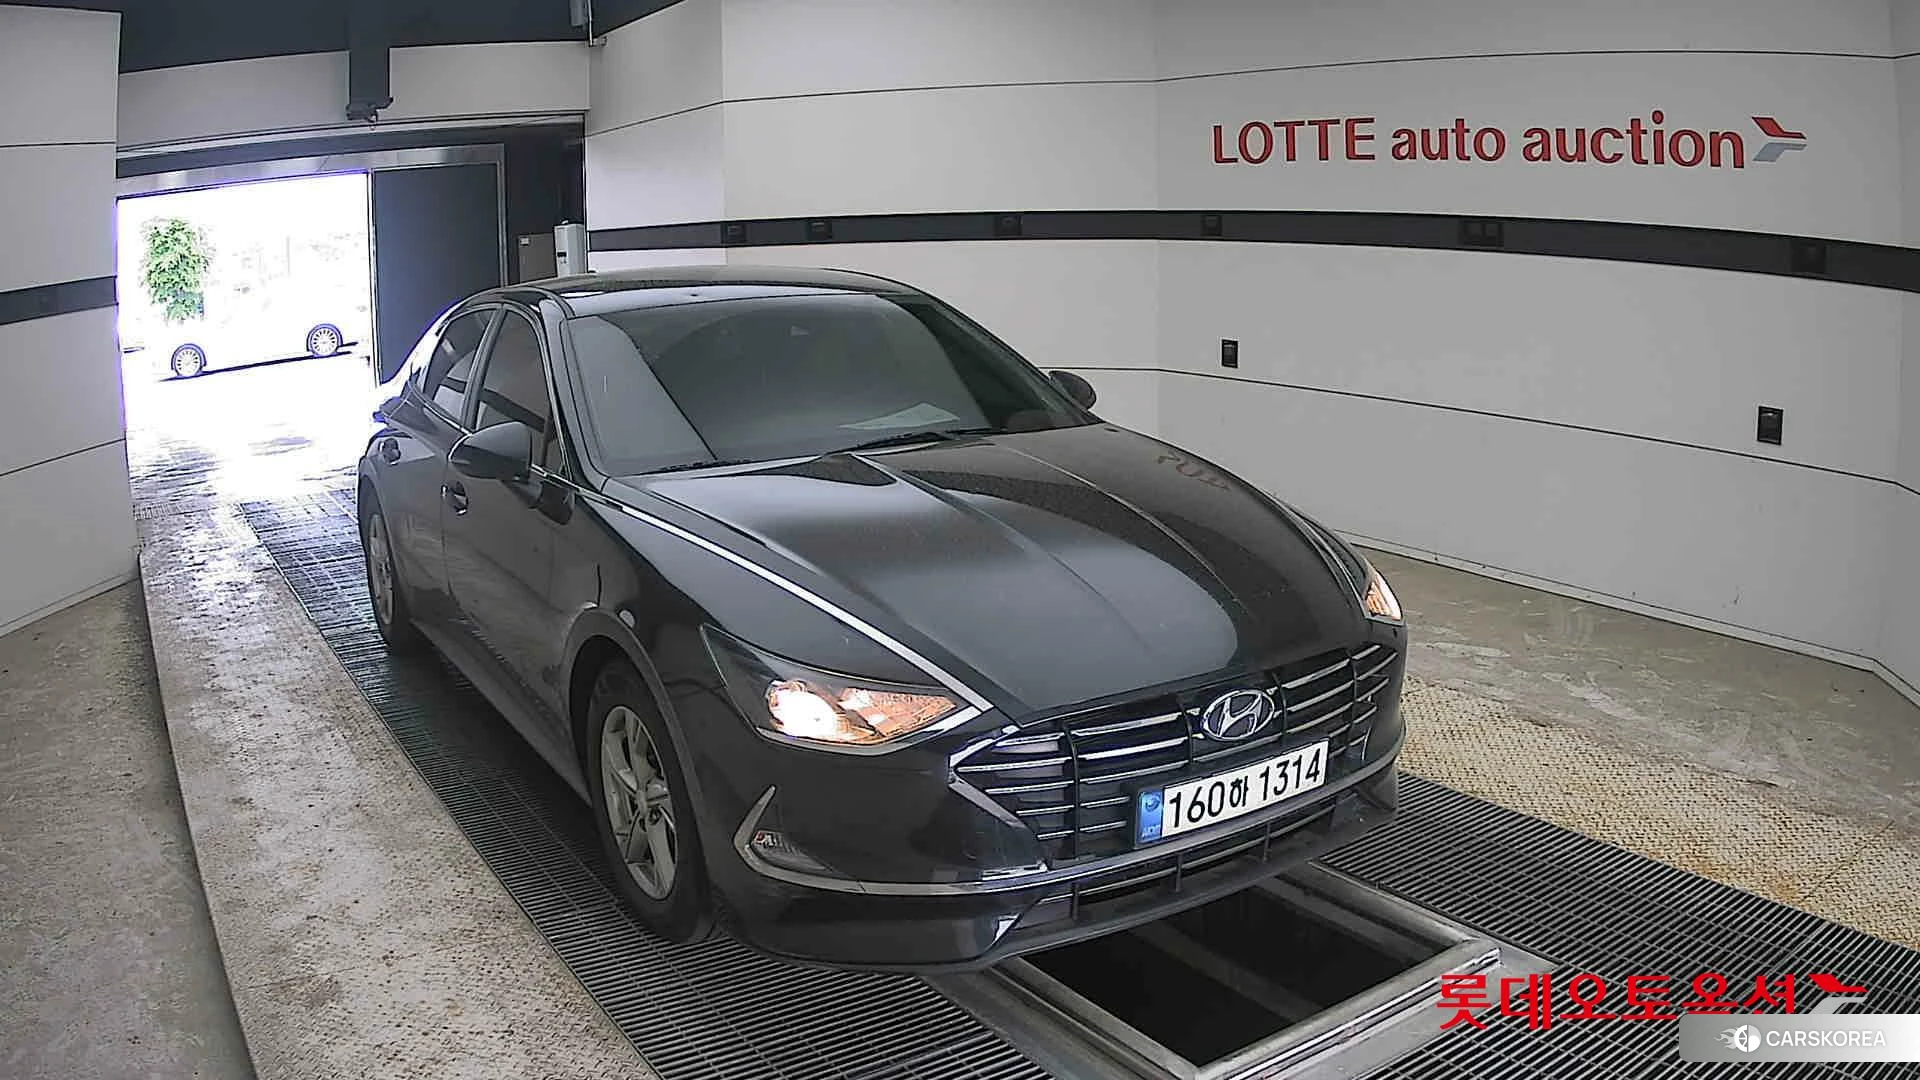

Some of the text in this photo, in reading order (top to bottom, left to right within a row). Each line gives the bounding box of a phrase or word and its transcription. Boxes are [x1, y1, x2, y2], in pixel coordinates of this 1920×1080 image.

[1213, 110, 1745, 169] LOTTE auto auction
[1169, 748, 1321, 828] 160하 1314
